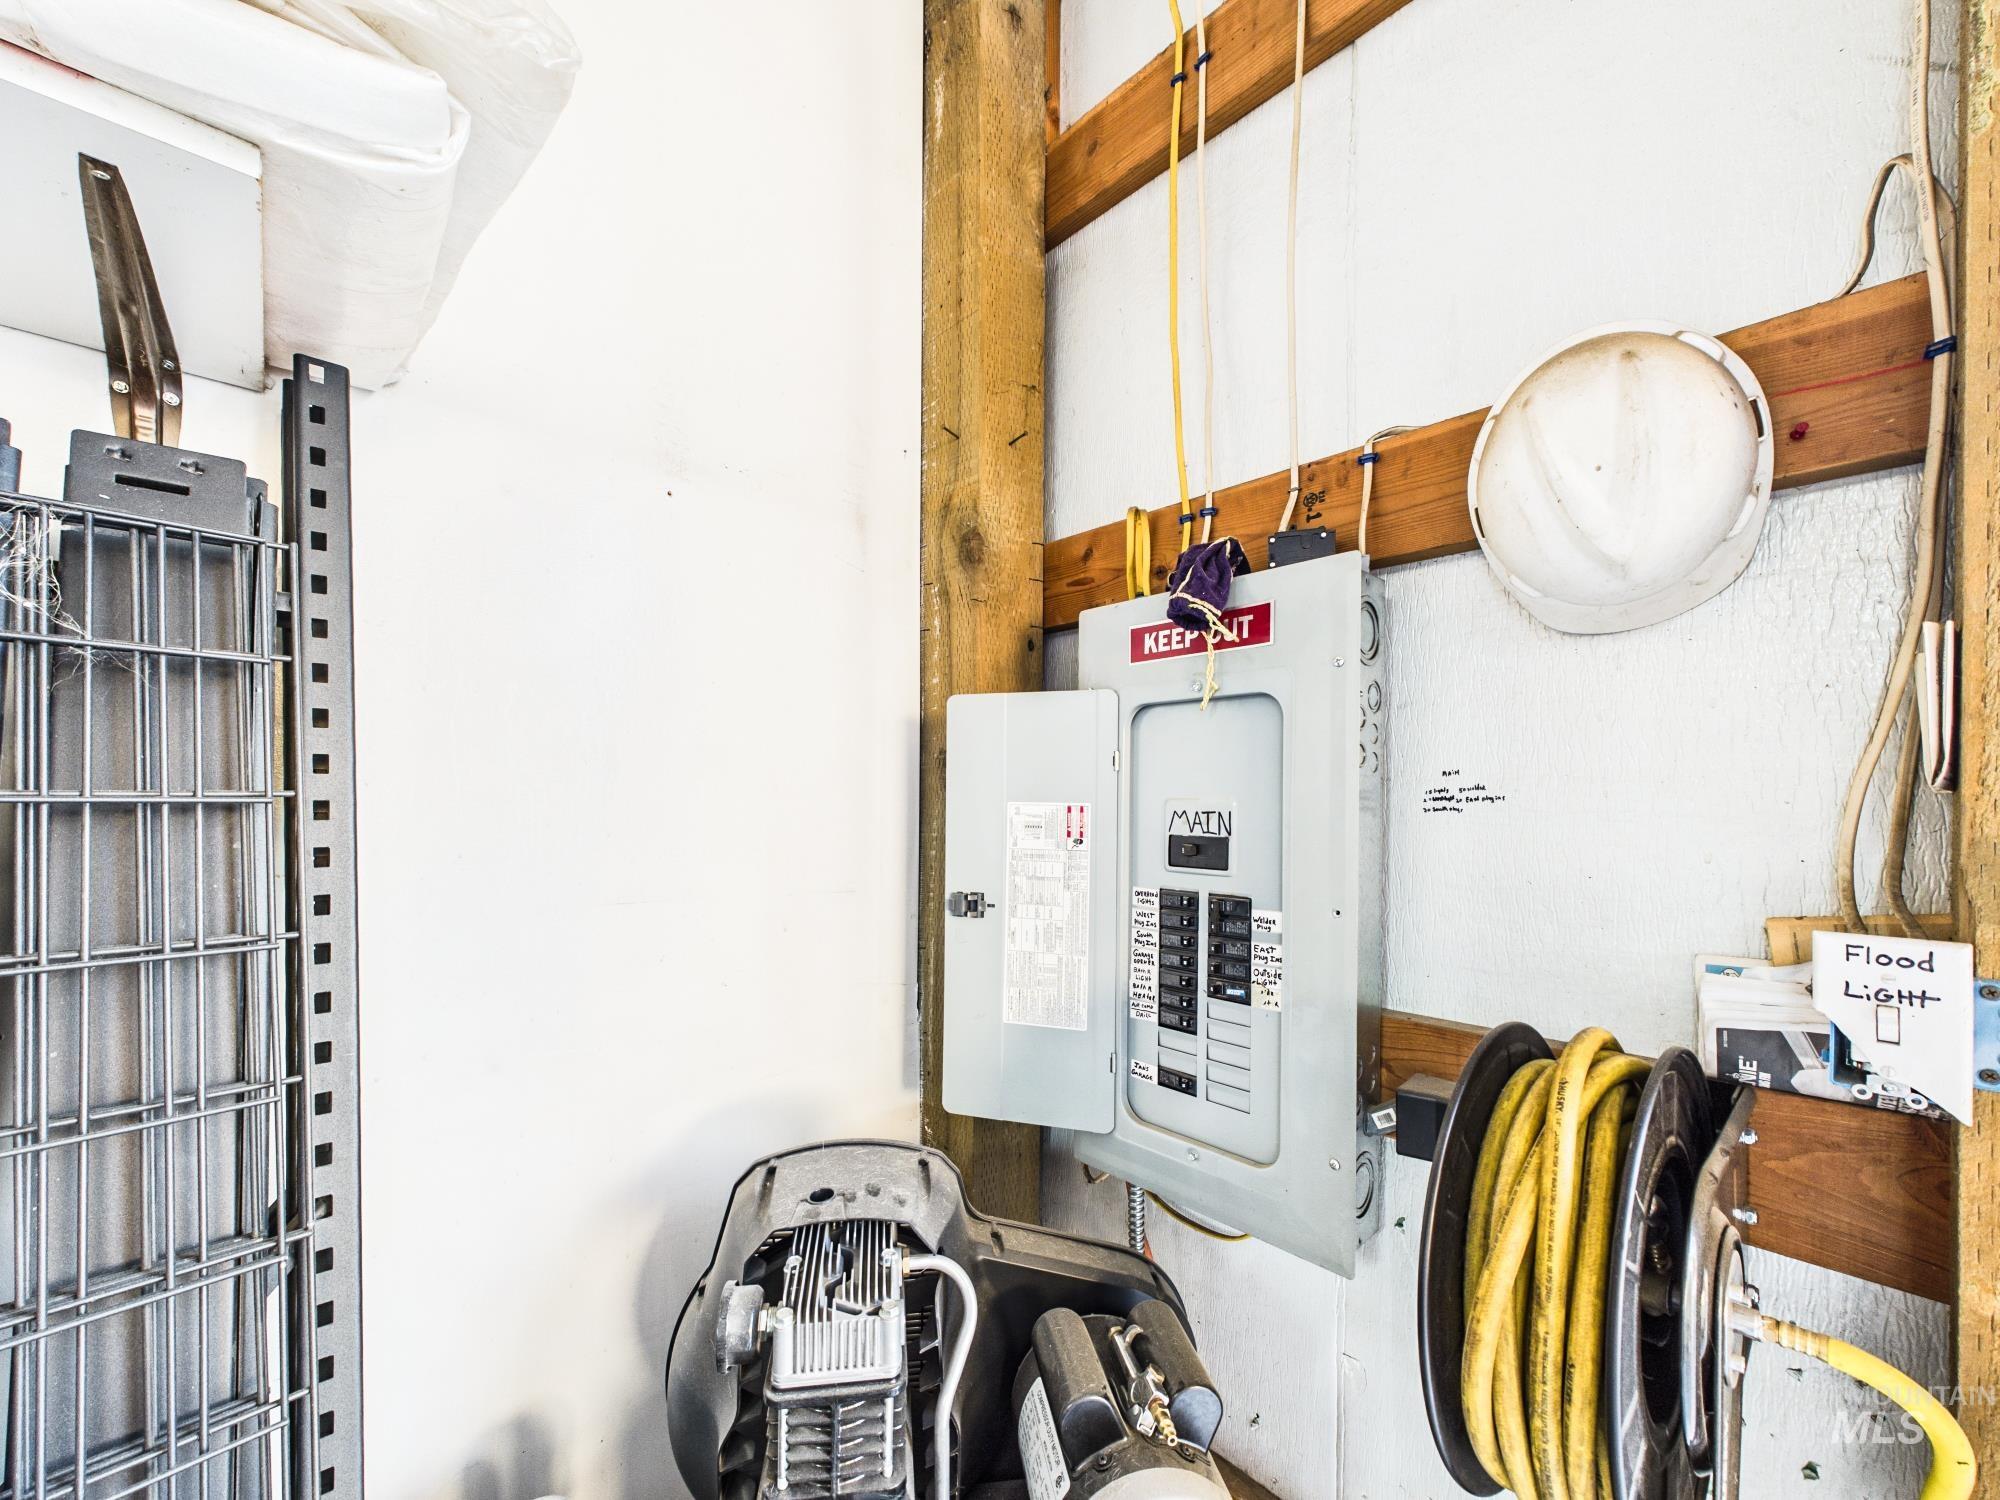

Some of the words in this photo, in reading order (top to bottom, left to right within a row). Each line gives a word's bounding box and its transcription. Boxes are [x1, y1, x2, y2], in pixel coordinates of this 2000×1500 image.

[1144, 627, 1200, 655] KEEP
[1168, 810, 1232, 836] MAIN
[1846, 944, 1935, 973] Flood
